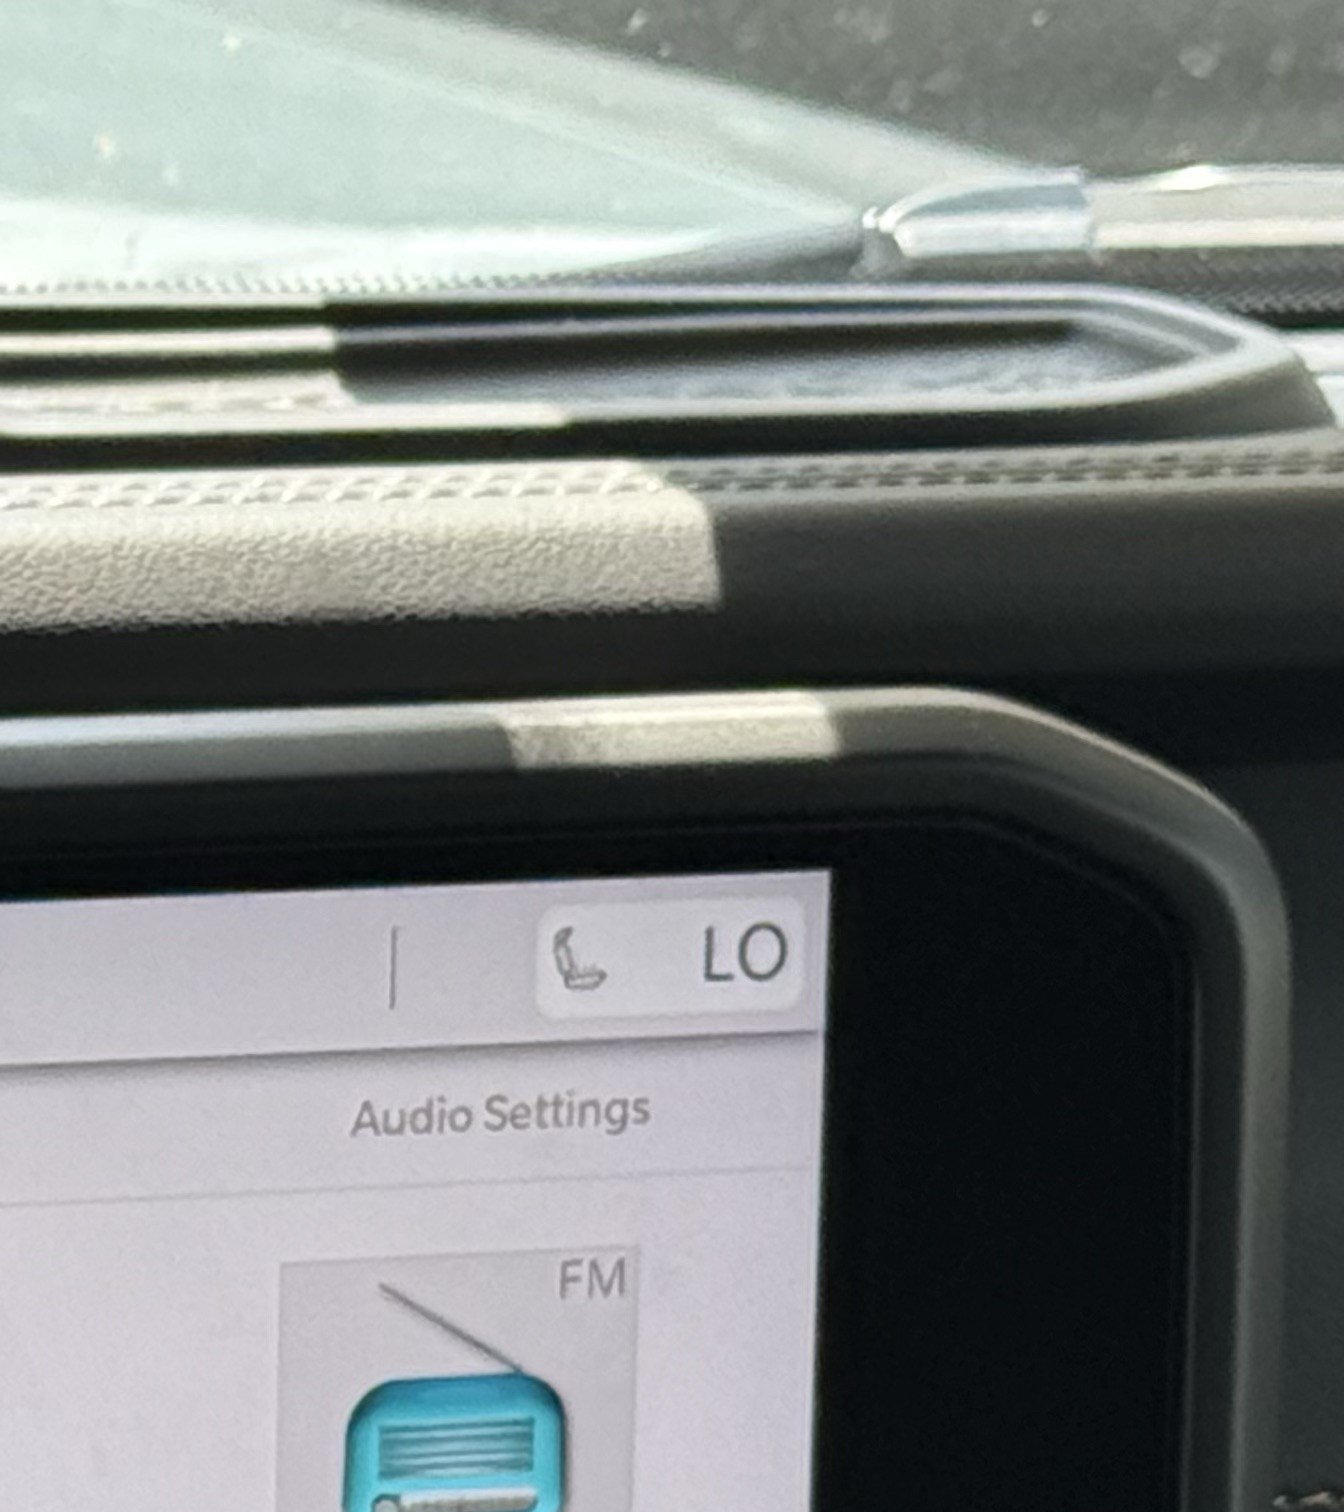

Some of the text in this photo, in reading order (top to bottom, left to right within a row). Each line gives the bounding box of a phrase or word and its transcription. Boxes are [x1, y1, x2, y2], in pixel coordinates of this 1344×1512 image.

[702, 922, 788, 984] LO
[349, 1090, 651, 1138] Audio Settings
[559, 1257, 628, 1300] FM
